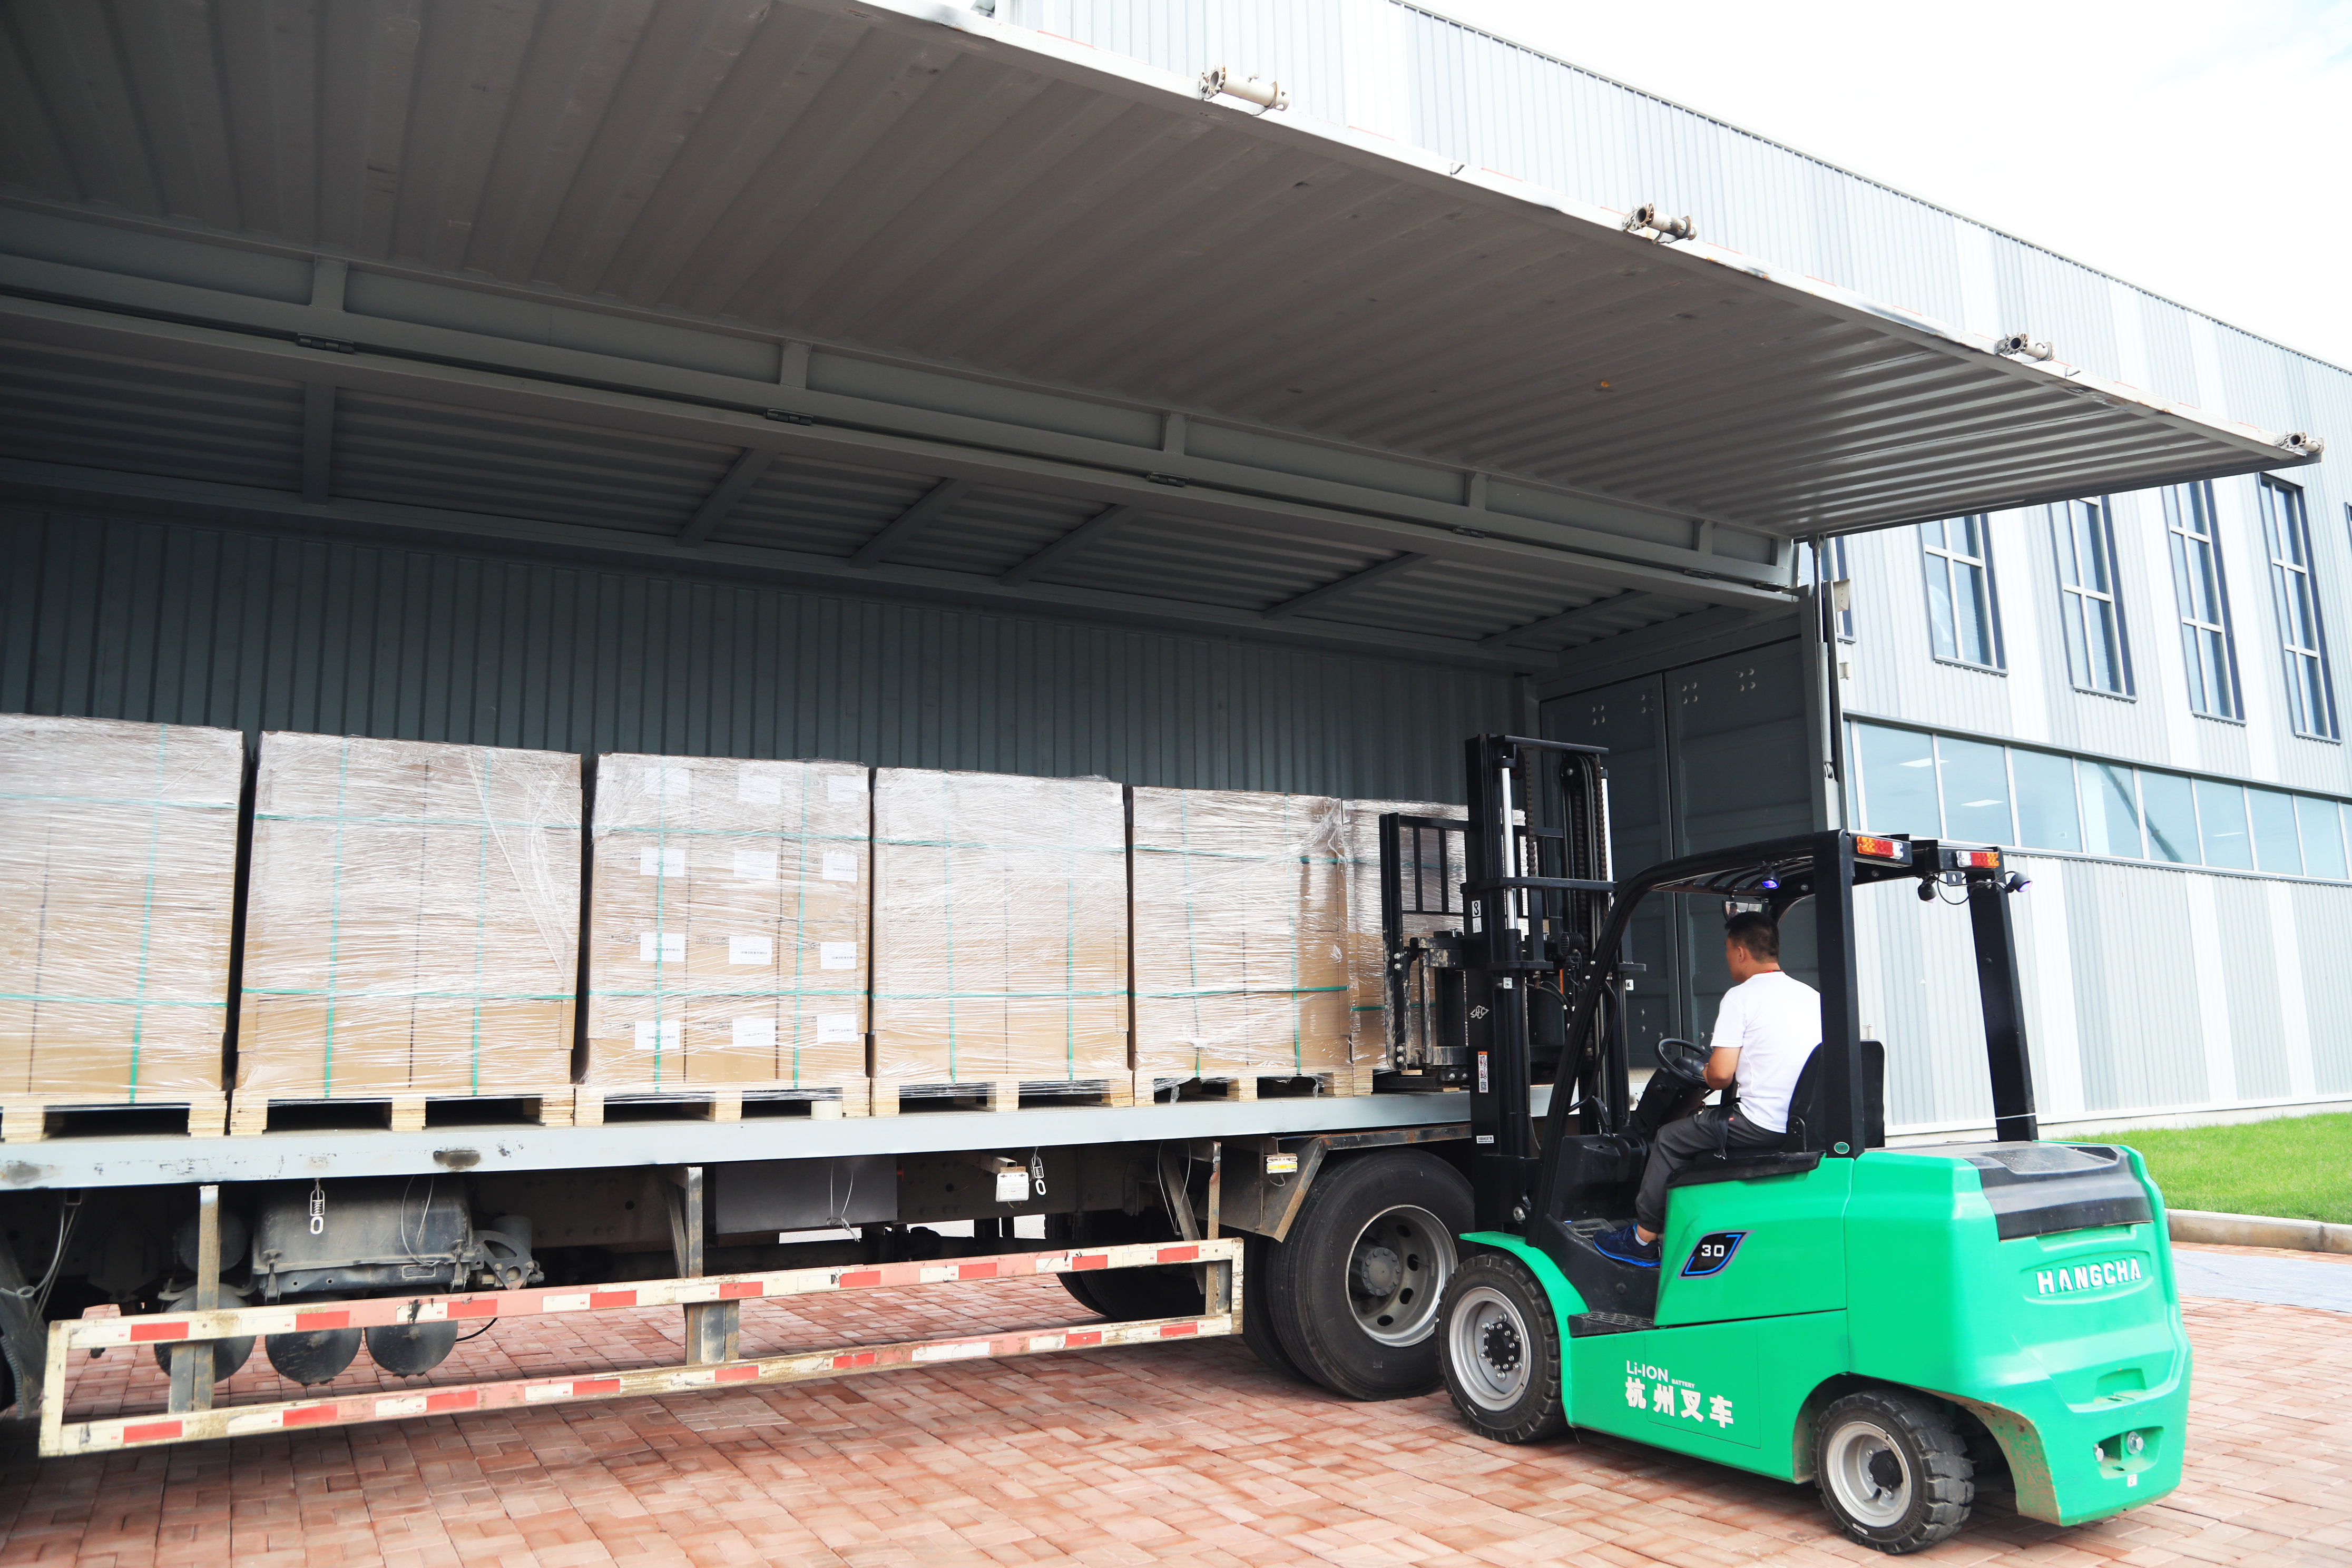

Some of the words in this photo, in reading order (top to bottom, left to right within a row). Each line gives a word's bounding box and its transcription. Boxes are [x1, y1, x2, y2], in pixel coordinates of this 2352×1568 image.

[1701, 1244, 1724, 1257] 30
[2036, 1257, 2142, 1294] HANGCHA
[1626, 1360, 1668, 1383] Li-ION
[1671, 1378, 1695, 1389] BATTERY
[1625, 1376, 1734, 1428] 杭州叉车
